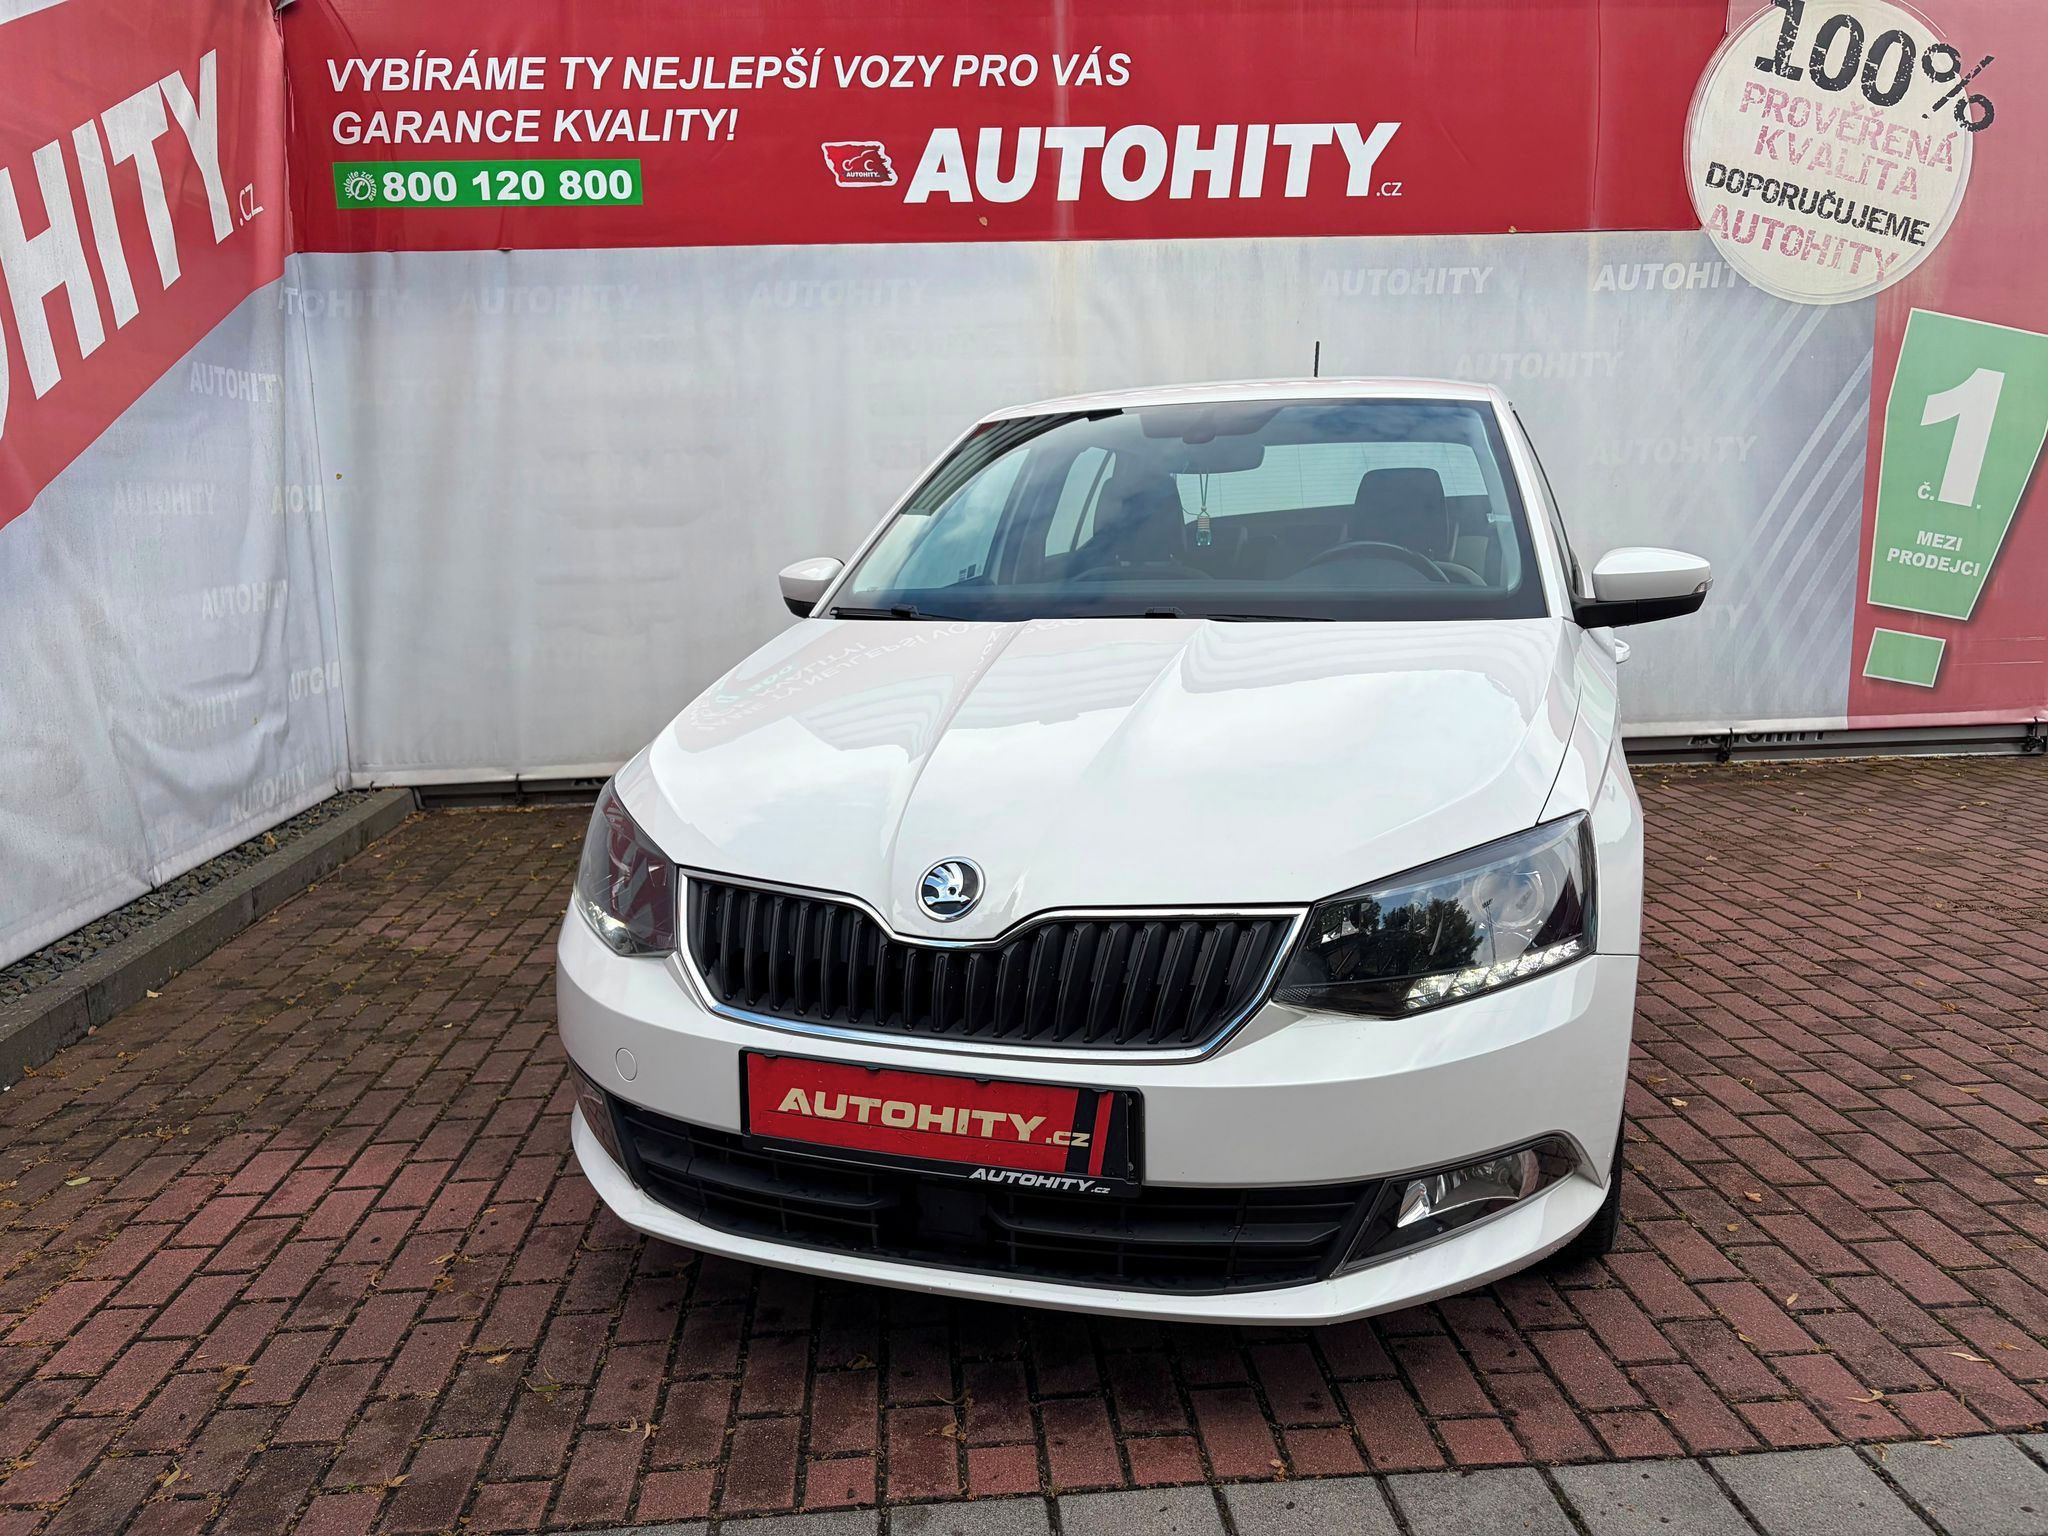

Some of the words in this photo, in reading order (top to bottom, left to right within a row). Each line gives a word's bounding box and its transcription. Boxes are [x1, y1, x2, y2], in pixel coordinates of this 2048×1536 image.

[327, 49, 546, 92] VYBÍRÁME
[559, 56, 614, 91] TY
[622, 47, 826, 90] NEJLEPŠÍ
[833, 54, 944, 88] VOZY
[952, 54, 1039, 88] PRO
[1051, 46, 1132, 87] VÁS
[1754, 0, 1995, 132] 100%
[332, 109, 542, 145] GARANCE
[553, 108, 739, 142] KVALITY!
[1738, 81, 1958, 173] PROVĚŘENÁ
[1754, 125, 1918, 200] KVALITA
[382, 171, 458, 202] 800
[471, 170, 545, 201] 120
[559, 169, 633, 200] 800
[1705, 161, 1931, 247] DOPORUČUJEME
[1700, 203, 1900, 283] AUTOHITY
[1316, 266, 1494, 298] AUTOHITY
[1592, 262, 1757, 292] AUTOHIT
[1453, 350, 1624, 381] AUTOHITY
[1916, 530, 1963, 552] MEZI
[1887, 547, 1981, 577] PRODEJCI
